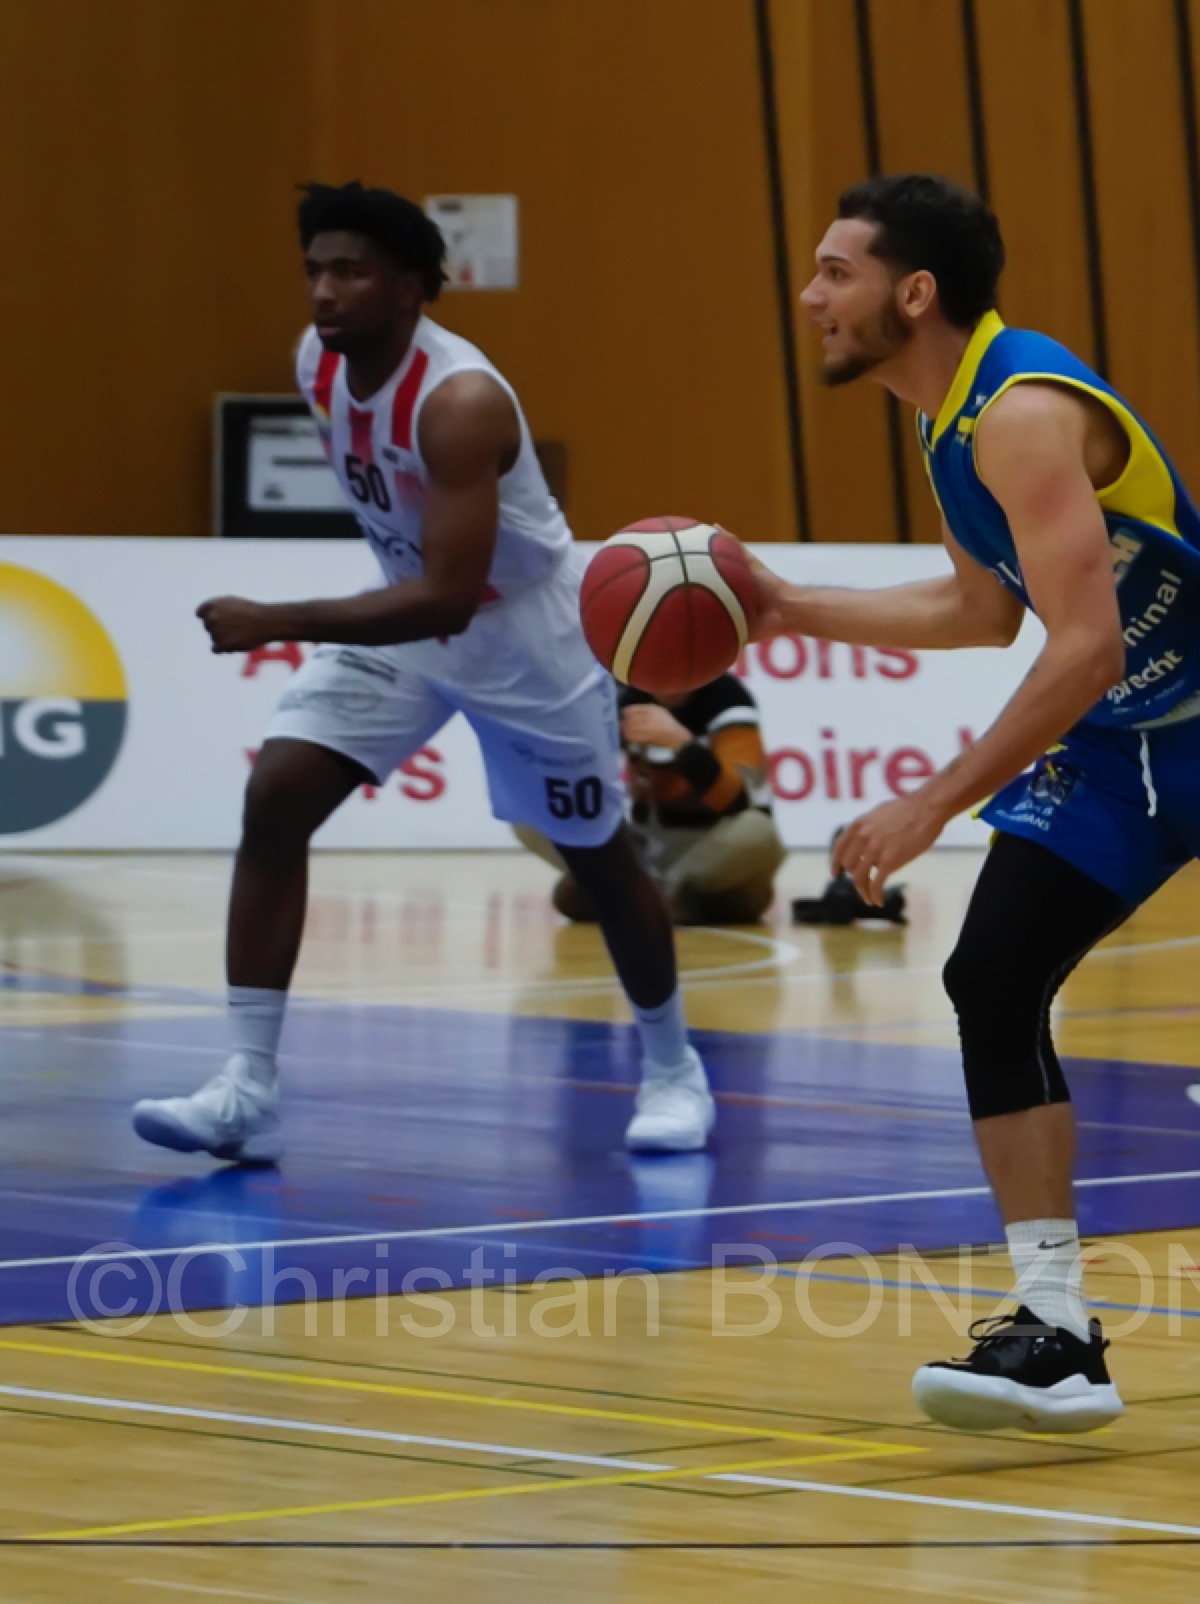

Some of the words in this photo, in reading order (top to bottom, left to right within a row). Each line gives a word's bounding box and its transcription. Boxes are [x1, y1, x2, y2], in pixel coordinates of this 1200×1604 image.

[344, 454, 392, 513] 50
[0, 697, 87, 759] G
[768, 727, 935, 801] oire
[545, 776, 603, 820] 50
